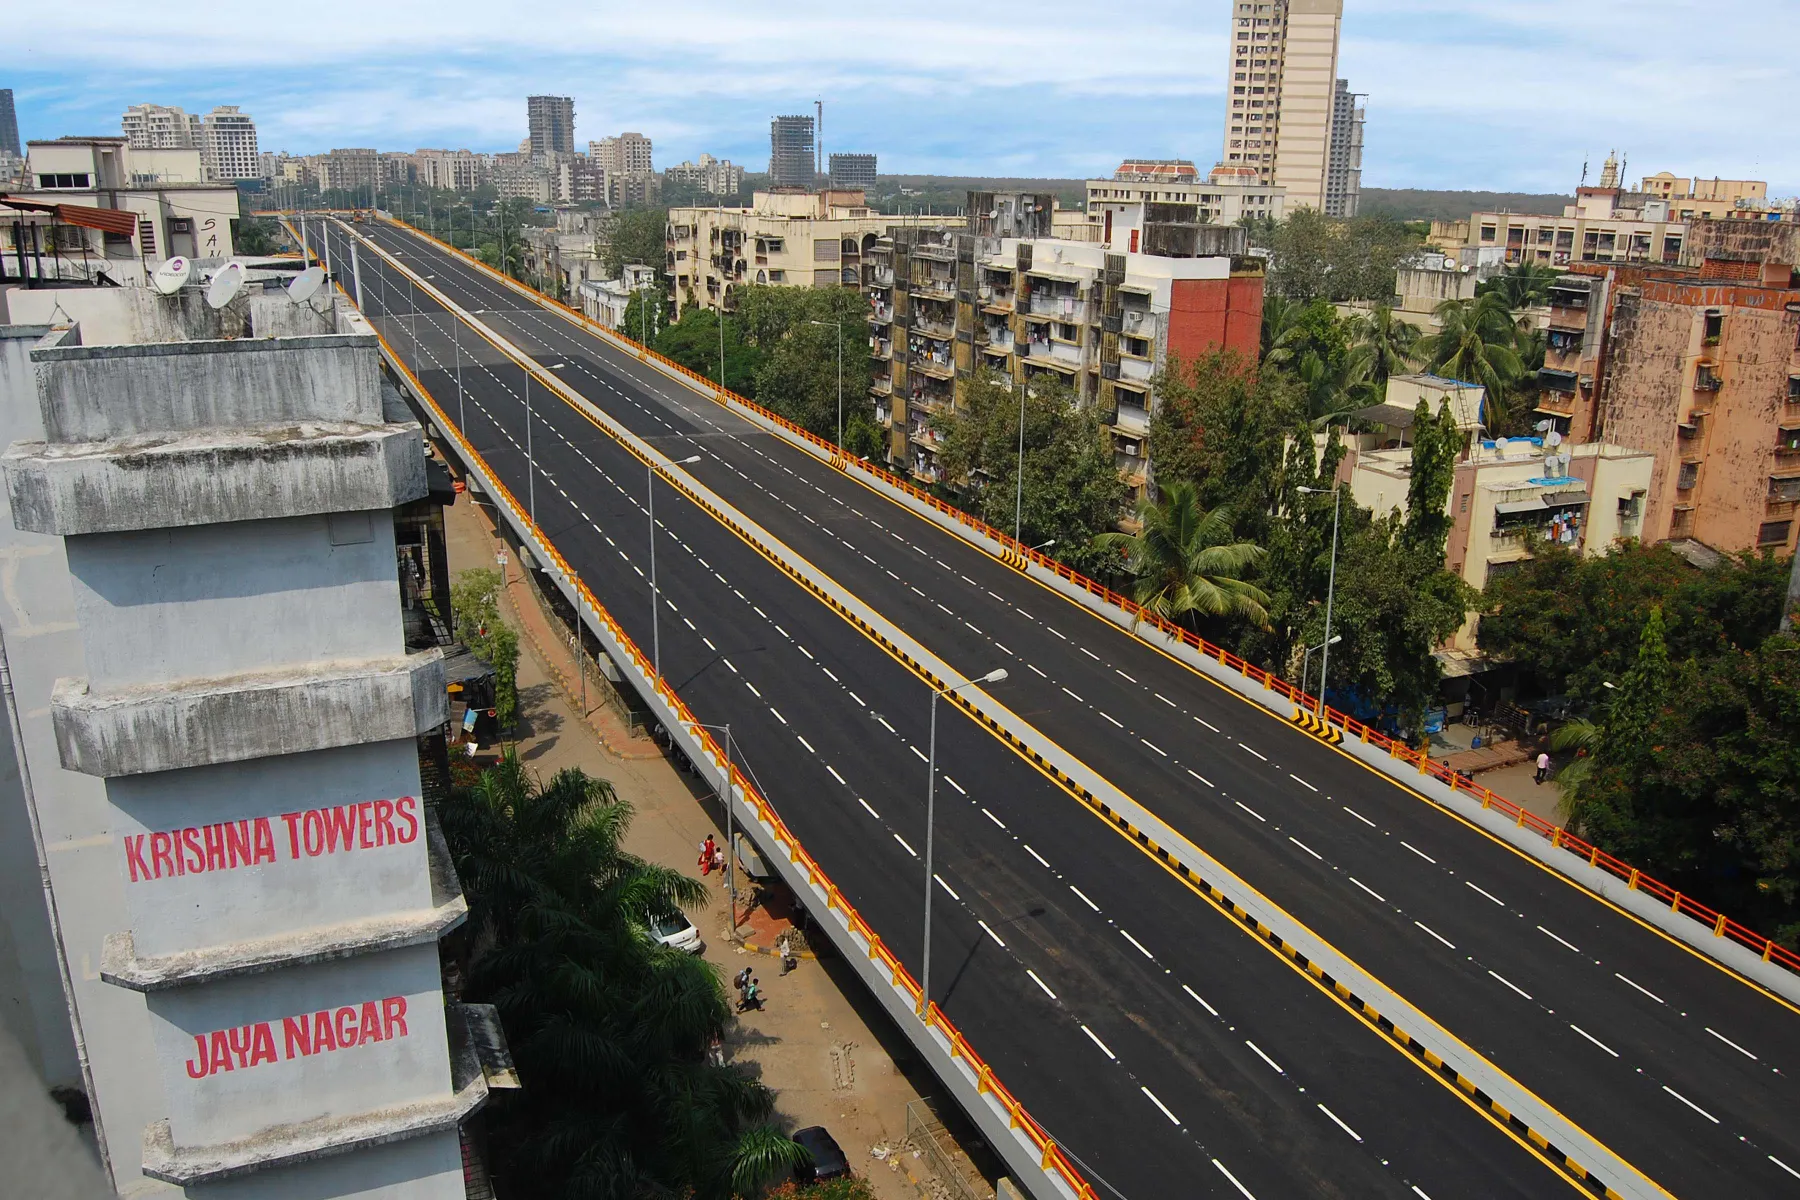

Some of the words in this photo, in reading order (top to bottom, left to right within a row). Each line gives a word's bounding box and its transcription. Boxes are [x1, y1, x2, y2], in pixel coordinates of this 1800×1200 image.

[124, 816, 277, 883] KRISHNA
[281, 796, 418, 860] TOWERS
[186, 1022, 278, 1079] JAYA
[282, 996, 409, 1060] NAGAR
